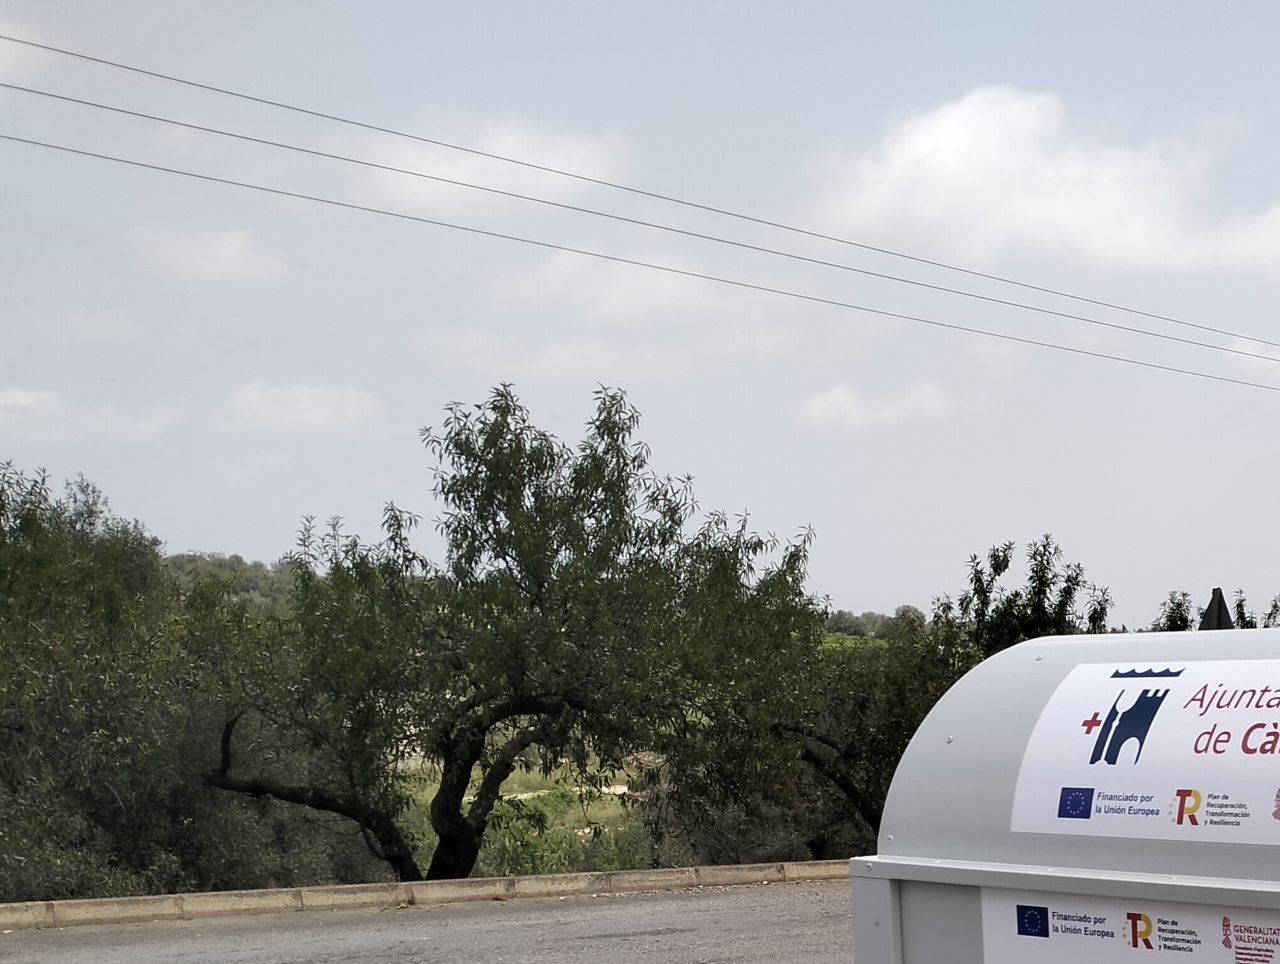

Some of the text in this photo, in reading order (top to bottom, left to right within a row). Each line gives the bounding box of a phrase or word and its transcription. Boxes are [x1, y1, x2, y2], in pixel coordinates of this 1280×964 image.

[1193, 724, 1230, 755] de
[1097, 792, 1154, 804] Financiado por
[1096, 806, 1160, 817] la Unión Europea
[1052, 911, 1106, 925] Financiado por
[1052, 924, 1115, 939] la Unión Europea
[1234, 925, 1280, 936] GENERALITAT
[1234, 935, 1280, 946] VALENCIANA
